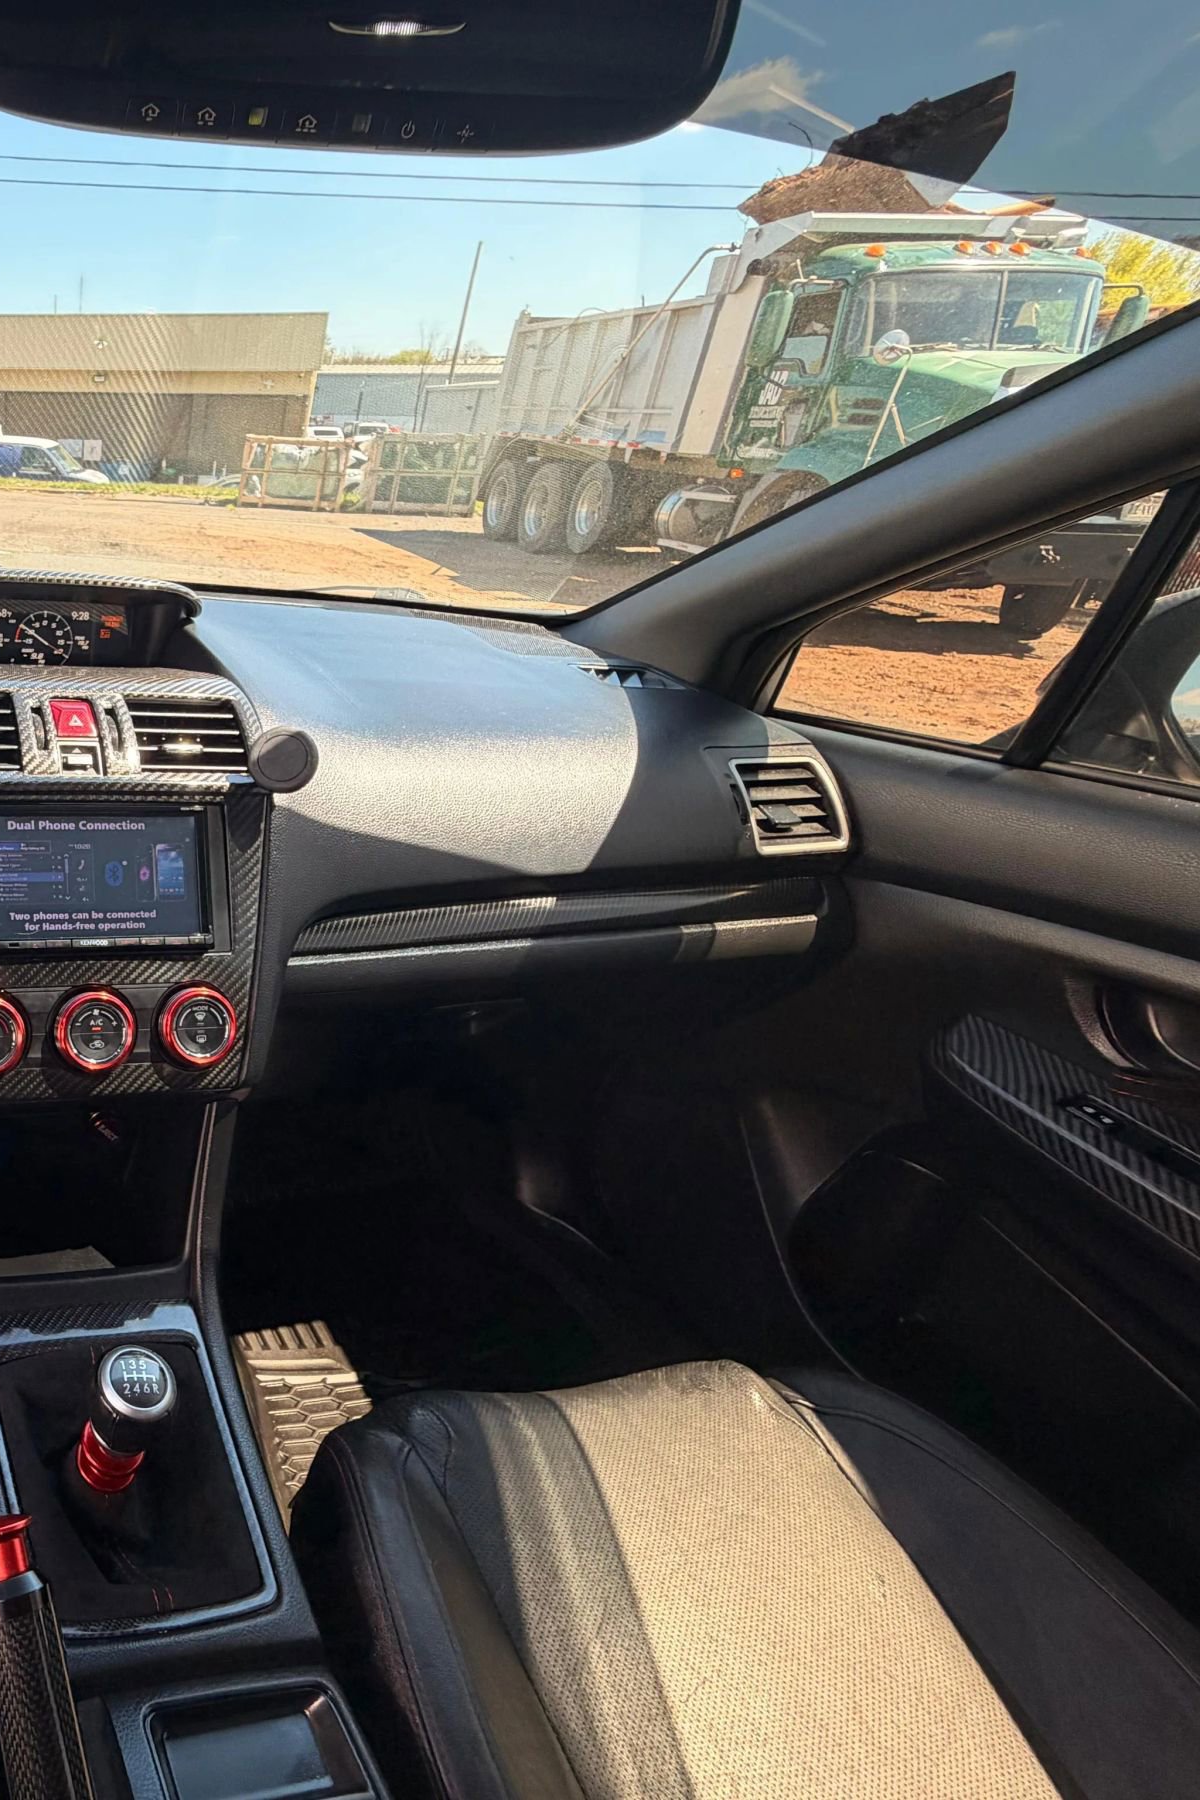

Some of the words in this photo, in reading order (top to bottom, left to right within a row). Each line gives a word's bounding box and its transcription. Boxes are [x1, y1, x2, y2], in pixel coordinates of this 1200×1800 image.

[71, 611, 90, 621] 9:28
[7, 820, 35, 830] Dual
[38, 820, 76, 830] Phone
[78, 820, 146, 830] Connection
[9, 912, 32, 921] Two
[33, 911, 70, 922] phones
[91, 911, 104, 919] be
[106, 910, 157, 919] connected
[24, 922, 41, 931] for
[42, 921, 95, 931] Hands-free
[98, 920, 146, 931] operation
[90, 1018, 104, 1026] A/C
[120, 1360, 127, 1370] 1
[129, 1360, 137, 1369] 3
[139, 1360, 146, 1370] 5
[123, 1383, 131, 1394] 2
[133, 1383, 140, 1393] 4
[143, 1383, 150, 1393] 6
[152, 1383, 159, 1394] R
